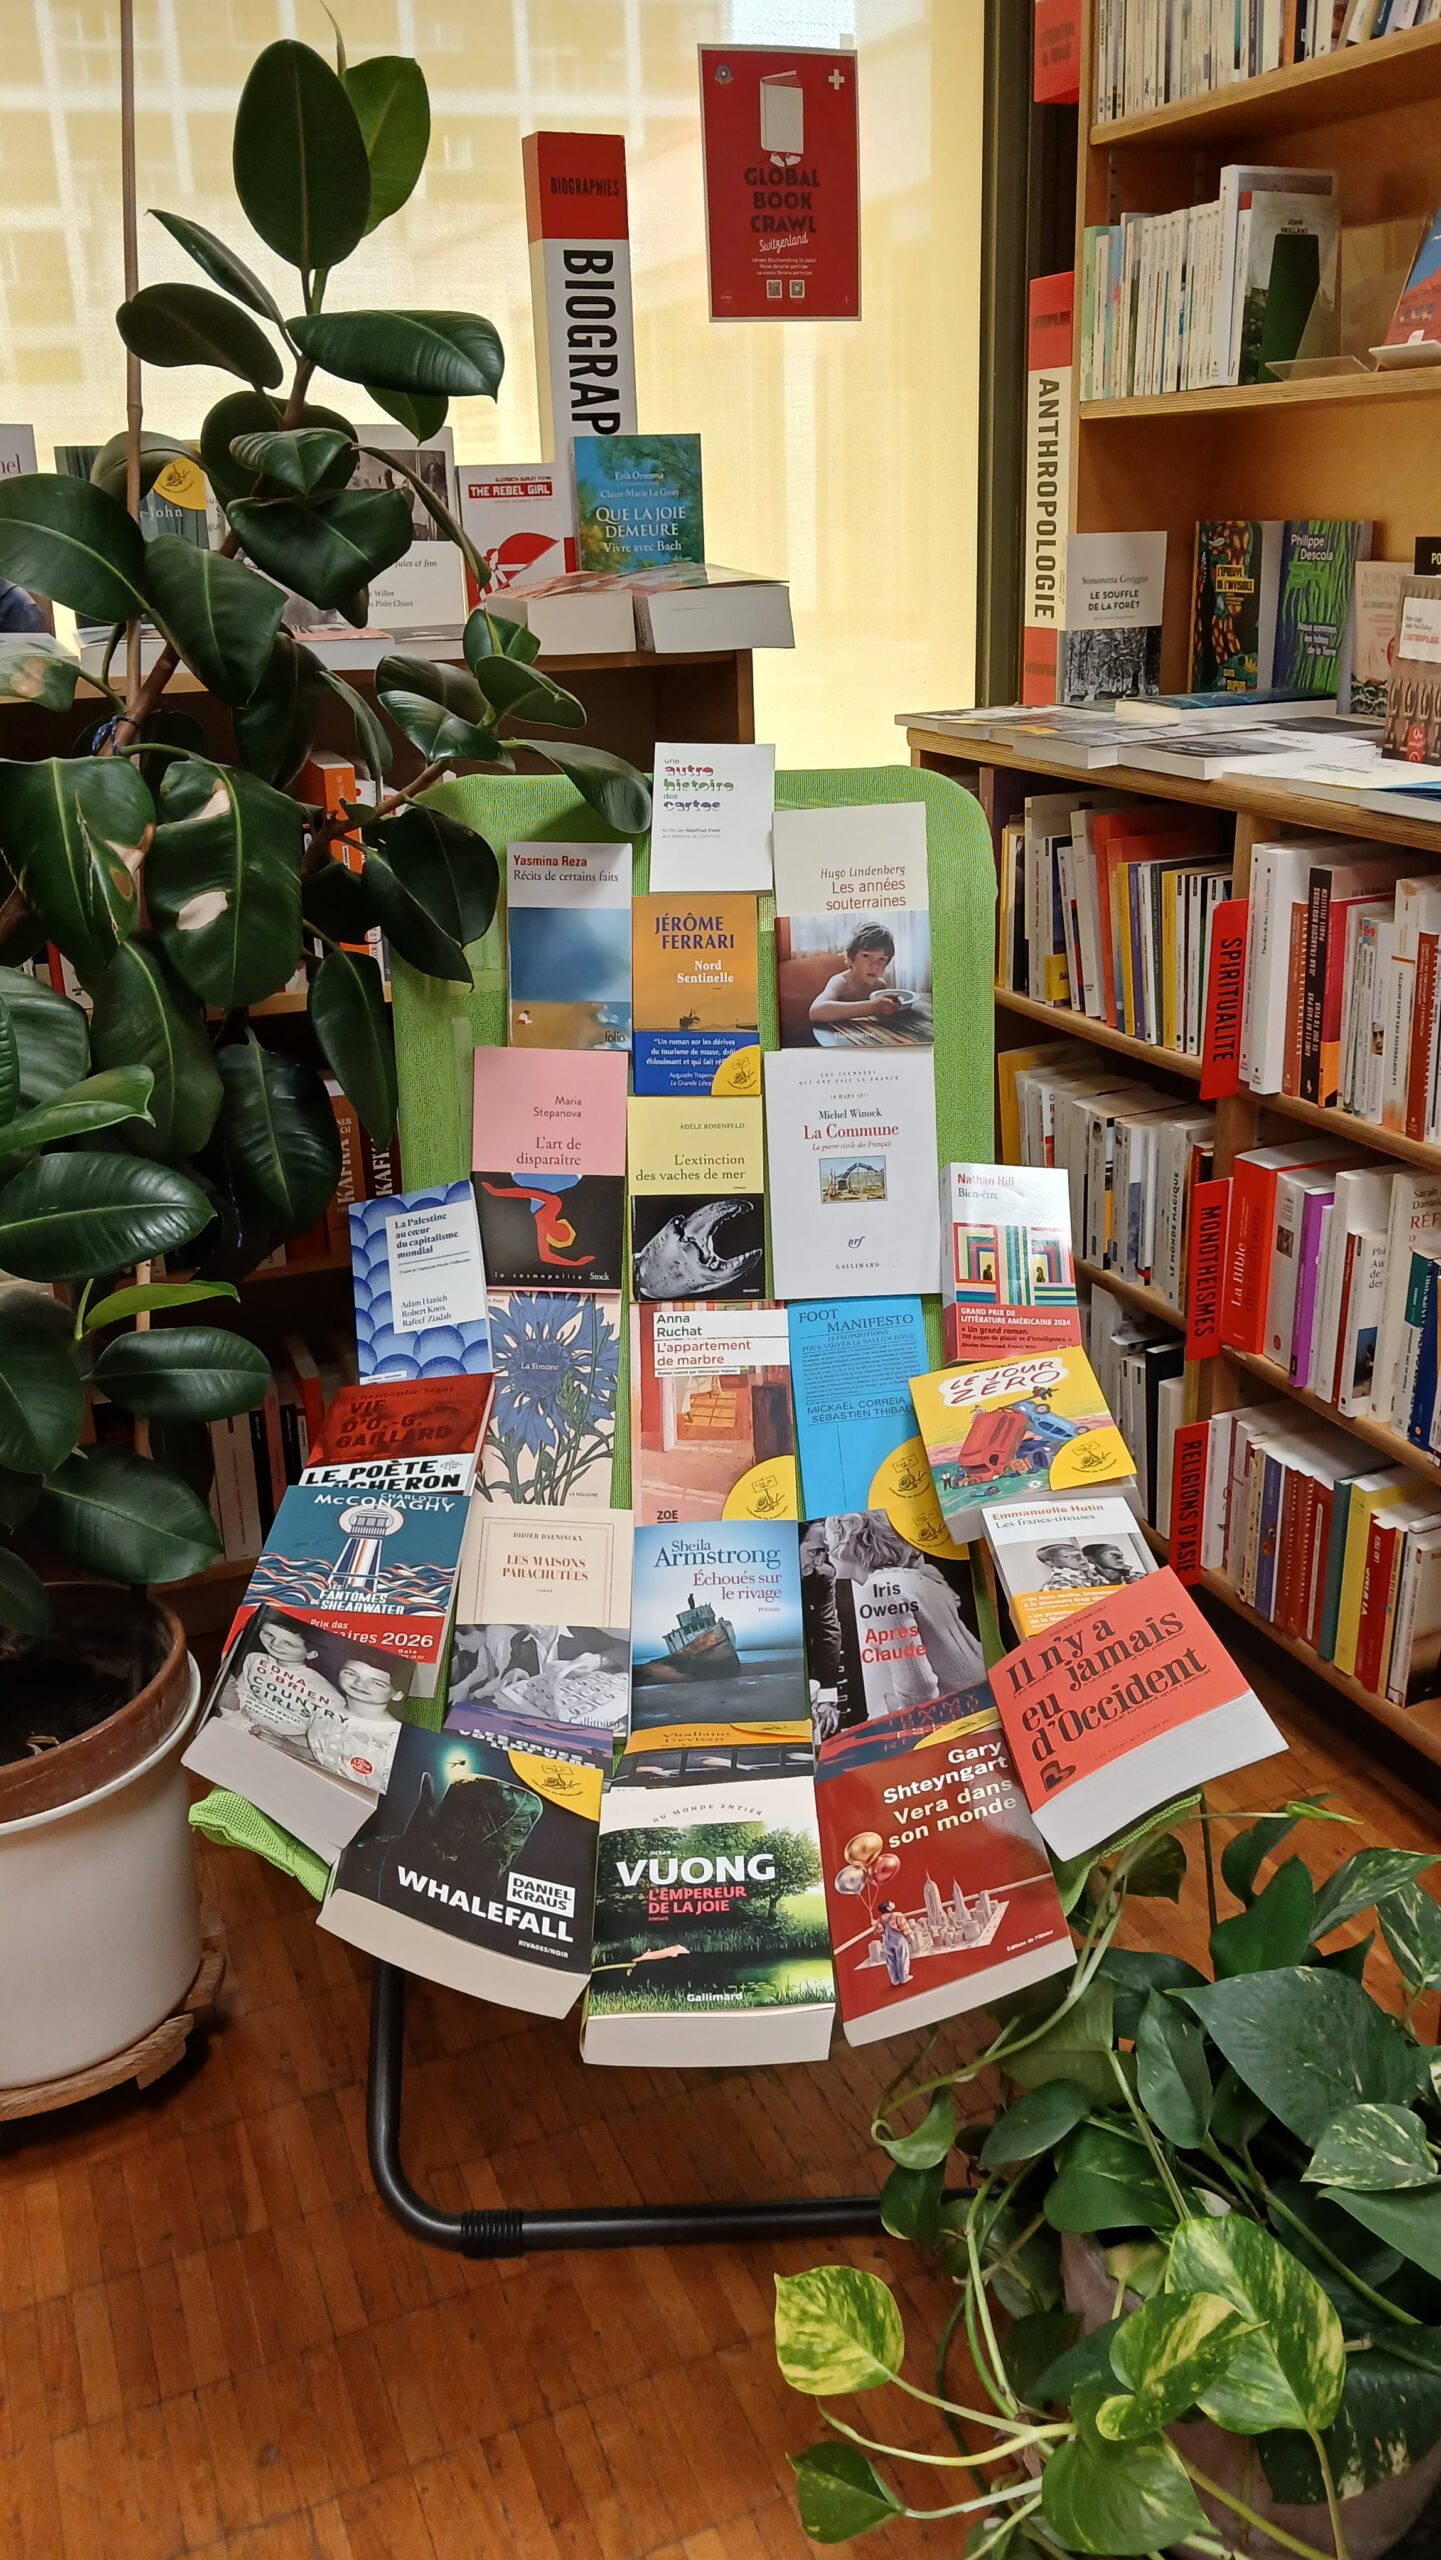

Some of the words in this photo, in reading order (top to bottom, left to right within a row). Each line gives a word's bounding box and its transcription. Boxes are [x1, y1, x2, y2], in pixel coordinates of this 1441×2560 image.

[744, 167, 820, 187] GLOBAL
[551, 177, 619, 196] BIOGRAPHIES
[753, 191, 812, 210] BOOK
[751, 215, 816, 233] CRAWL
[759, 233, 809, 253] Switzerland
[470, 486, 490, 497] THE
[493, 485, 525, 496] REBEL
[528, 483, 550, 495] GIRL
[1034, 378, 1060, 619] ANTHROPOLOGIE
[149, 505, 183, 519] John
[596, 506, 629, 523] QUE
[634, 508, 652, 519] LA
[656, 506, 686, 522] JOIE
[606, 523, 679, 538] DEMEURE
[604, 541, 630, 553] Vivre
[633, 543, 655, 552] avec
[657, 540, 682, 551] Bach
[1291, 533, 1325, 550] Philippe
[1300, 548, 1334, 561] Descola
[1081, 575, 1118, 585] Simonetta
[1119, 574, 1149, 587] Greggio
[1090, 591, 1101, 600] LE
[1103, 589, 1139, 600] SOUFFLE
[664, 765, 714, 776] autre
[663, 778, 734, 792] histoire
[663, 800, 721, 812] cartes
[514, 855, 559, 866] Yasmina
[562, 855, 587, 866] Reza
[514, 869, 541, 880] Récits
[545, 869, 556, 881] de
[559, 870, 596, 882] certains
[599, 871, 619, 882] faits
[820, 868, 846, 880] Hugo
[849, 865, 906, 877] Lindenberg
[832, 881, 854, 894] Les
[859, 877, 906, 892] années
[826, 896, 906, 911] souterraines
[655, 913, 724, 934] JÉRÔME
[662, 934, 735, 949] FERRARI
[695, 960, 722, 971] Nord
[677, 972, 734, 984] Sentinelle
[604, 1031, 625, 1043] folio
[555, 1096, 582, 1106] Maria
[533, 1107, 582, 1120] Stepanova
[818, 1110, 848, 1120] Michel
[849, 1108, 882, 1118] Winock
[803, 1125, 823, 1140] La
[826, 1122, 899, 1138] Commune
[536, 1137, 563, 1151] L'art
[566, 1138, 581, 1150] de
[516, 1151, 581, 1169] disparaître
[674, 1153, 745, 1166] L'extinction
[636, 1169, 656, 1181] des
[660, 1168, 700, 1181] vaches
[704, 1168, 718, 1180] de
[722, 1170, 745, 1180] mer
[958, 1187, 999, 1200] Bien-être
[1171, 1172, 1180, 1222] MAGIQUE
[395, 1220, 406, 1229] La
[407, 1213, 447, 1227] Palestine
[397, 1239, 408, 1249] du
[409, 1231, 458, 1246] capitalisme
[1170, 1223, 1178, 1264] MONDE
[397, 1246, 433, 1259] mondial
[1169, 1268, 1176, 1276] LE
[657, 1314, 690, 1324] Anna
[799, 1309, 838, 1323] FOOT
[961, 1307, 986, 1316] GRAND
[988, 1308, 1005, 1316] PRIX
[827, 1313, 914, 1333] MANIFESTO
[961, 1315, 1006, 1325] LITTÉRATURE
[1007, 1317, 1053, 1326] AMÉRICAINE
[657, 1326, 702, 1337] Ruchat
[657, 1340, 751, 1354] L'appartement
[657, 1356, 673, 1366] de
[677, 1354, 725, 1365] marbre
[951, 1375, 979, 1390] LE
[985, 1359, 1054, 1381] JOUR
[950, 1371, 1060, 1405] ZÉRO
[351, 1400, 387, 1415] VIE
[807, 1402, 855, 1414] MICKAËL
[858, 1396, 905, 1408] CORREIA
[335, 1425, 453, 1449] GAILLARD
[305, 1469, 340, 1484] LE
[348, 1460, 438, 1481] POÈTE
[1178, 1439, 1203, 1519] RELIGIONS
[314, 1494, 455, 1512] McCONAGHY
[381, 1493, 449, 1503] CHARLOTTE
[657, 1510, 678, 1520] ZOE
[992, 1506, 1068, 1521] Emmanuelle
[1071, 1503, 1104, 1512] Hutin
[995, 1521, 1015, 1529] Les
[1017, 1513, 1096, 1527] francs-tireuses
[672, 1539, 711, 1552] Sheila
[506, 1555, 529, 1566] LES
[533, 1556, 586, 1568] MAISONS
[654, 1546, 781, 1570] Armstrong
[502, 1567, 589, 1581] PARACHUTÉES
[693, 1569, 756, 1586] Échoués
[758, 1574, 782, 1584] sur
[319, 1589, 388, 1603] FANTÔMES
[722, 1586, 734, 1600] le
[738, 1589, 782, 1602] rivage
[873, 1582, 901, 1598] Iris
[859, 1600, 919, 1618] Owens
[311, 1618, 329, 1629] Prix
[331, 1620, 348, 1629] des
[381, 1633, 434, 1648] 2026
[862, 1643, 927, 1664] Claude
[1006, 1657, 1036, 1693] Il
[1038, 1630, 1083, 1674] n'y
[1092, 1619, 1115, 1642] a
[1065, 1611, 1184, 1692] jamais
[259, 1659, 306, 1686] EDNA
[253, 1676, 349, 1723] COUNTRY
[1031, 1647, 1207, 1762] d'Occident
[1021, 1693, 1064, 1732] eu
[948, 1742, 1001, 1764] Gary
[883, 1756, 1008, 1804] Shteyngart
[893, 1798, 948, 1825] Vera
[957, 1778, 1013, 1805] dans
[652, 1814, 666, 1823] DU
[673, 1803, 714, 1815] MONDE
[721, 1803, 763, 1816] ENTIER
[888, 1825, 930, 1848] son
[937, 1797, 1017, 1832] monde
[616, 1853, 775, 1887] VUONG
[513, 1877, 572, 1900] DANIEL
[649, 1886, 746, 1900] L'EMPEREUR
[397, 1865, 574, 1942] WHALEFALL
[512, 1887, 567, 1910] KRAUS
[649, 1902, 669, 1914] DE
[673, 1901, 693, 1913] LA
[696, 1900, 730, 1915] JOIE
[518, 1939, 568, 1958] RIVAGES/NOIR
[687, 1992, 743, 2003] Gallimard
